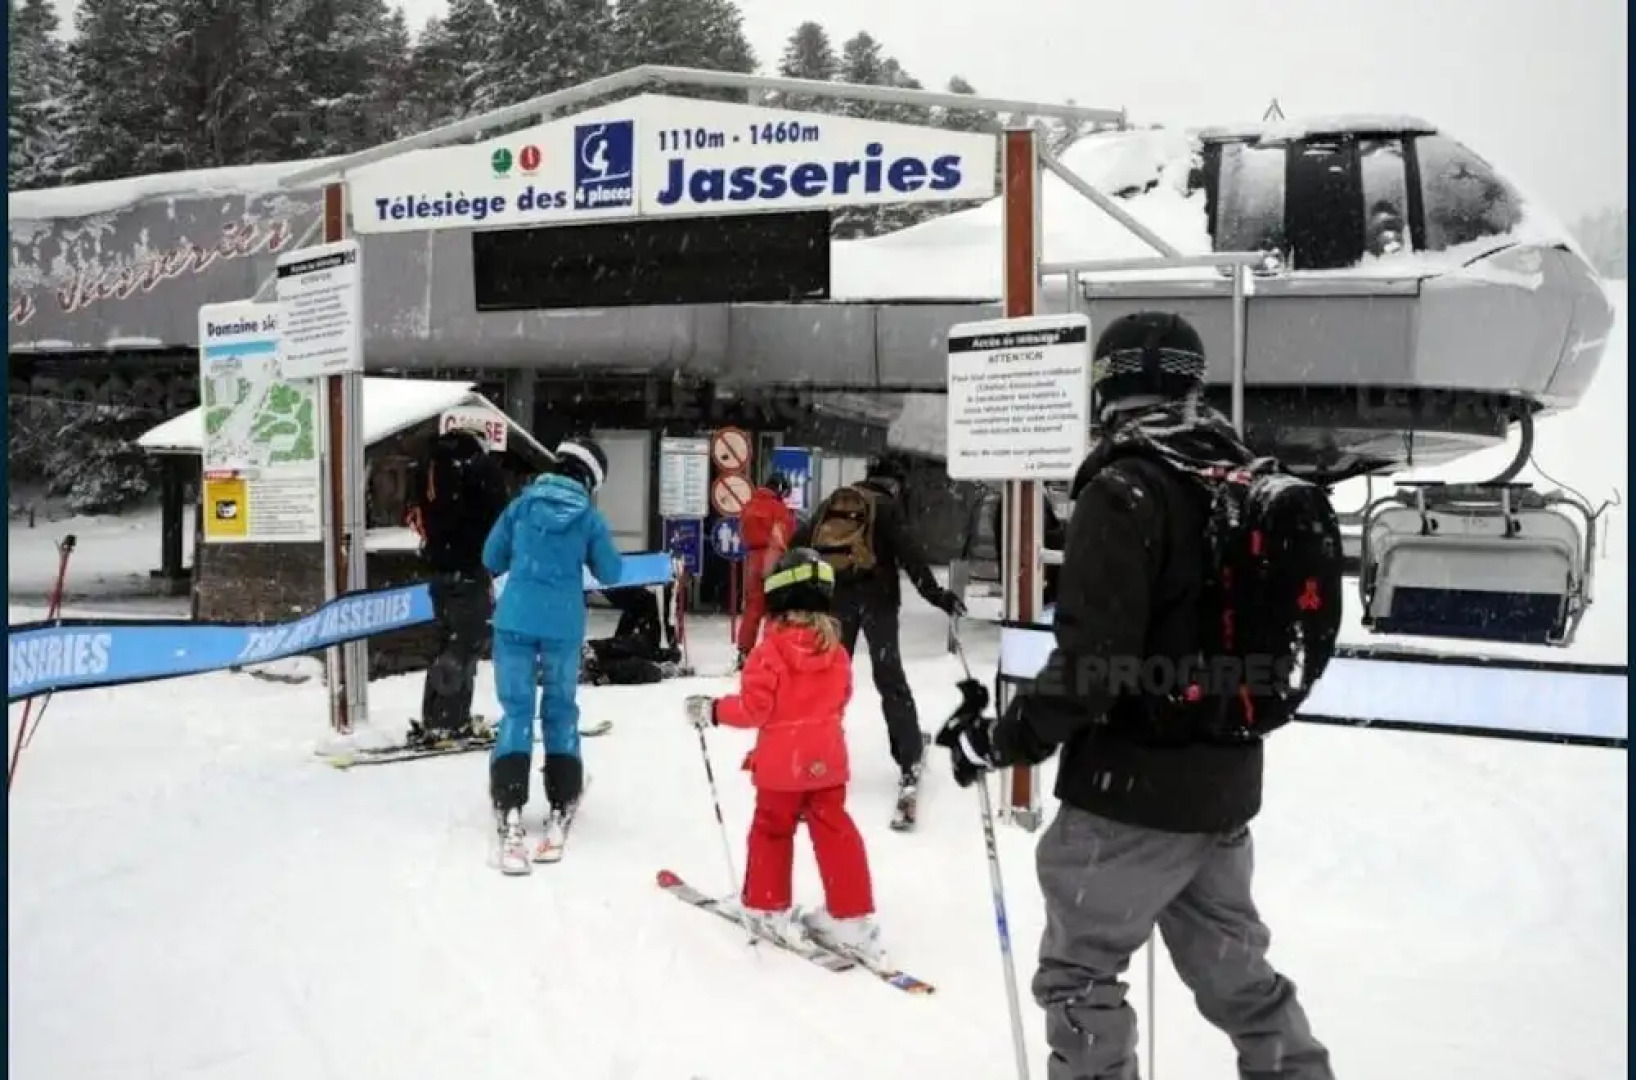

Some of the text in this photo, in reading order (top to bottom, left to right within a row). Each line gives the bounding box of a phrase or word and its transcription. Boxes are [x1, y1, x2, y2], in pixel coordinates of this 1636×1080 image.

[657, 129, 725, 152] 1110m
[750, 121, 820, 145] 1460m
[656, 142, 962, 205] Jasseries
[375, 185, 567, 221] Télésiège des
[588, 185, 632, 207] places
[207, 315, 258, 338] Domaine
